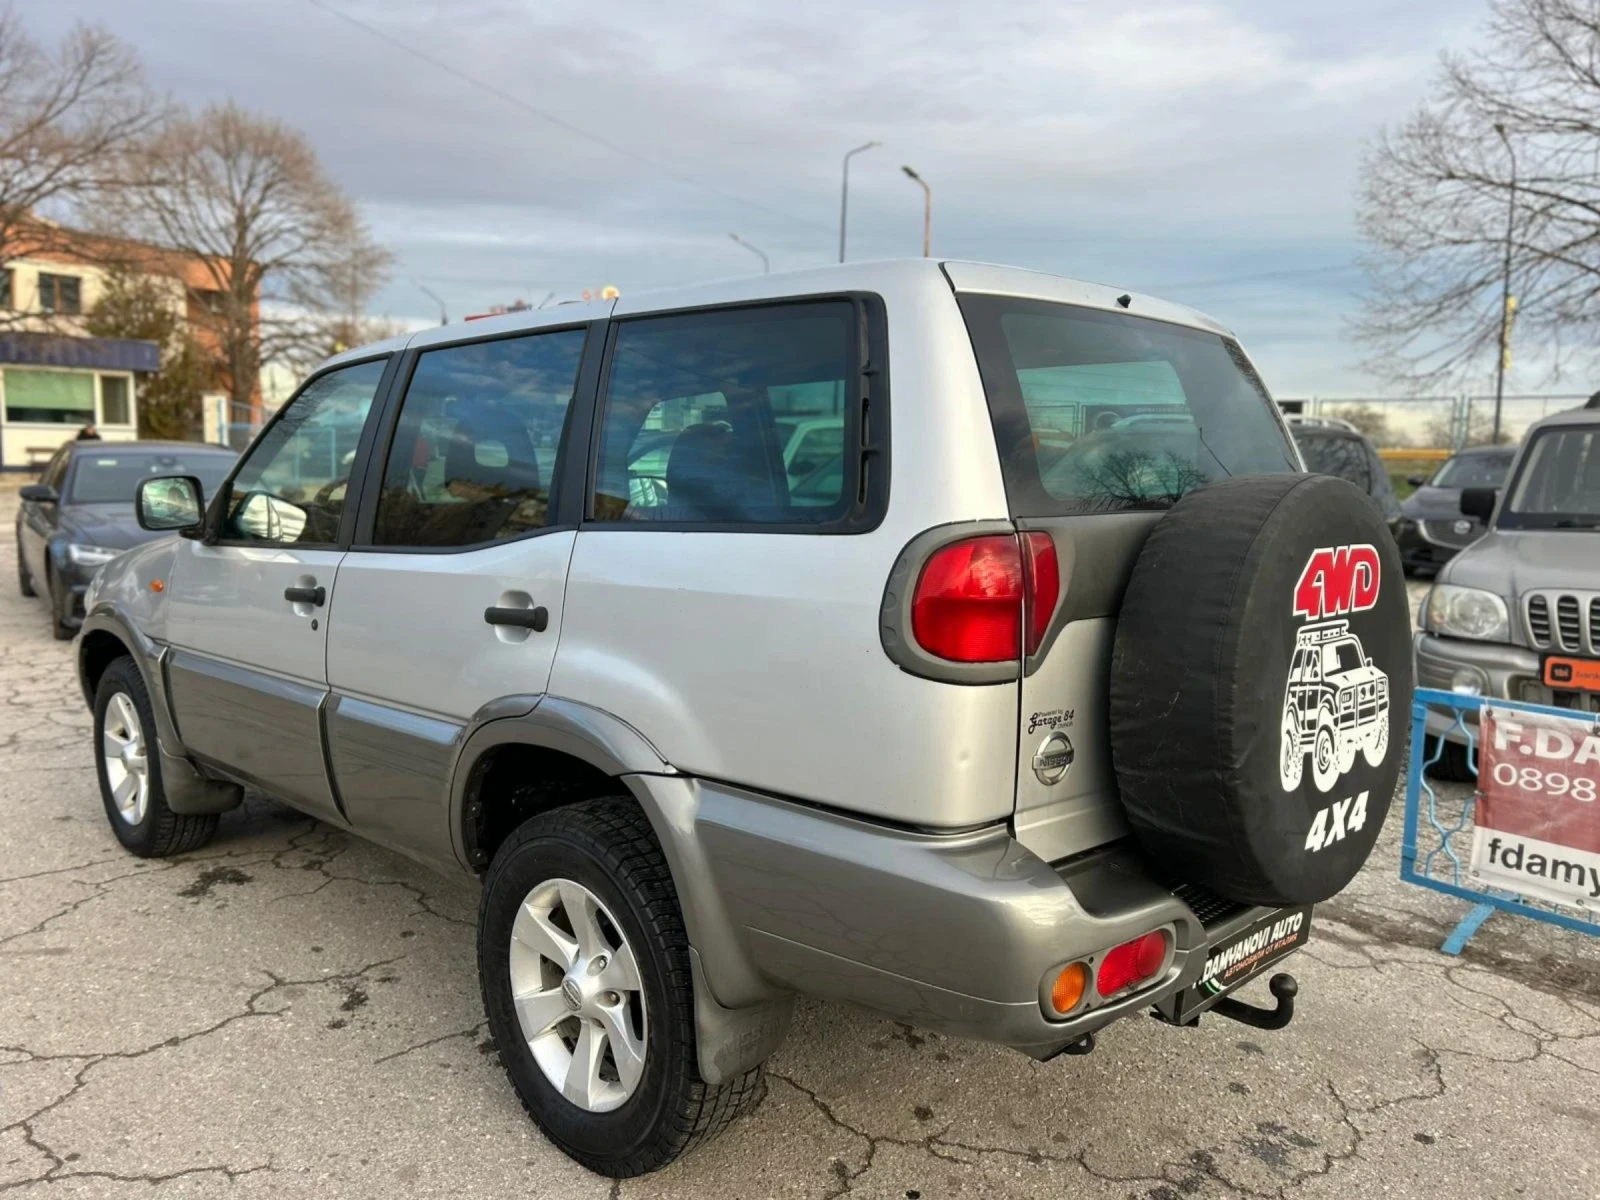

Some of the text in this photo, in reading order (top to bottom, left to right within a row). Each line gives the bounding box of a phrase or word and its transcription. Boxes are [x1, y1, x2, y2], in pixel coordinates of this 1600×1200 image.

[1292, 544, 1381, 621] 4WD
[1028, 712, 1062, 734] Garage
[1063, 709, 1075, 721] 84
[1039, 755, 1072, 767] NISSAN
[1493, 763, 1597, 802] 0898
[1304, 790, 1370, 853] 4X4
[1270, 911, 1303, 943] AUTO
